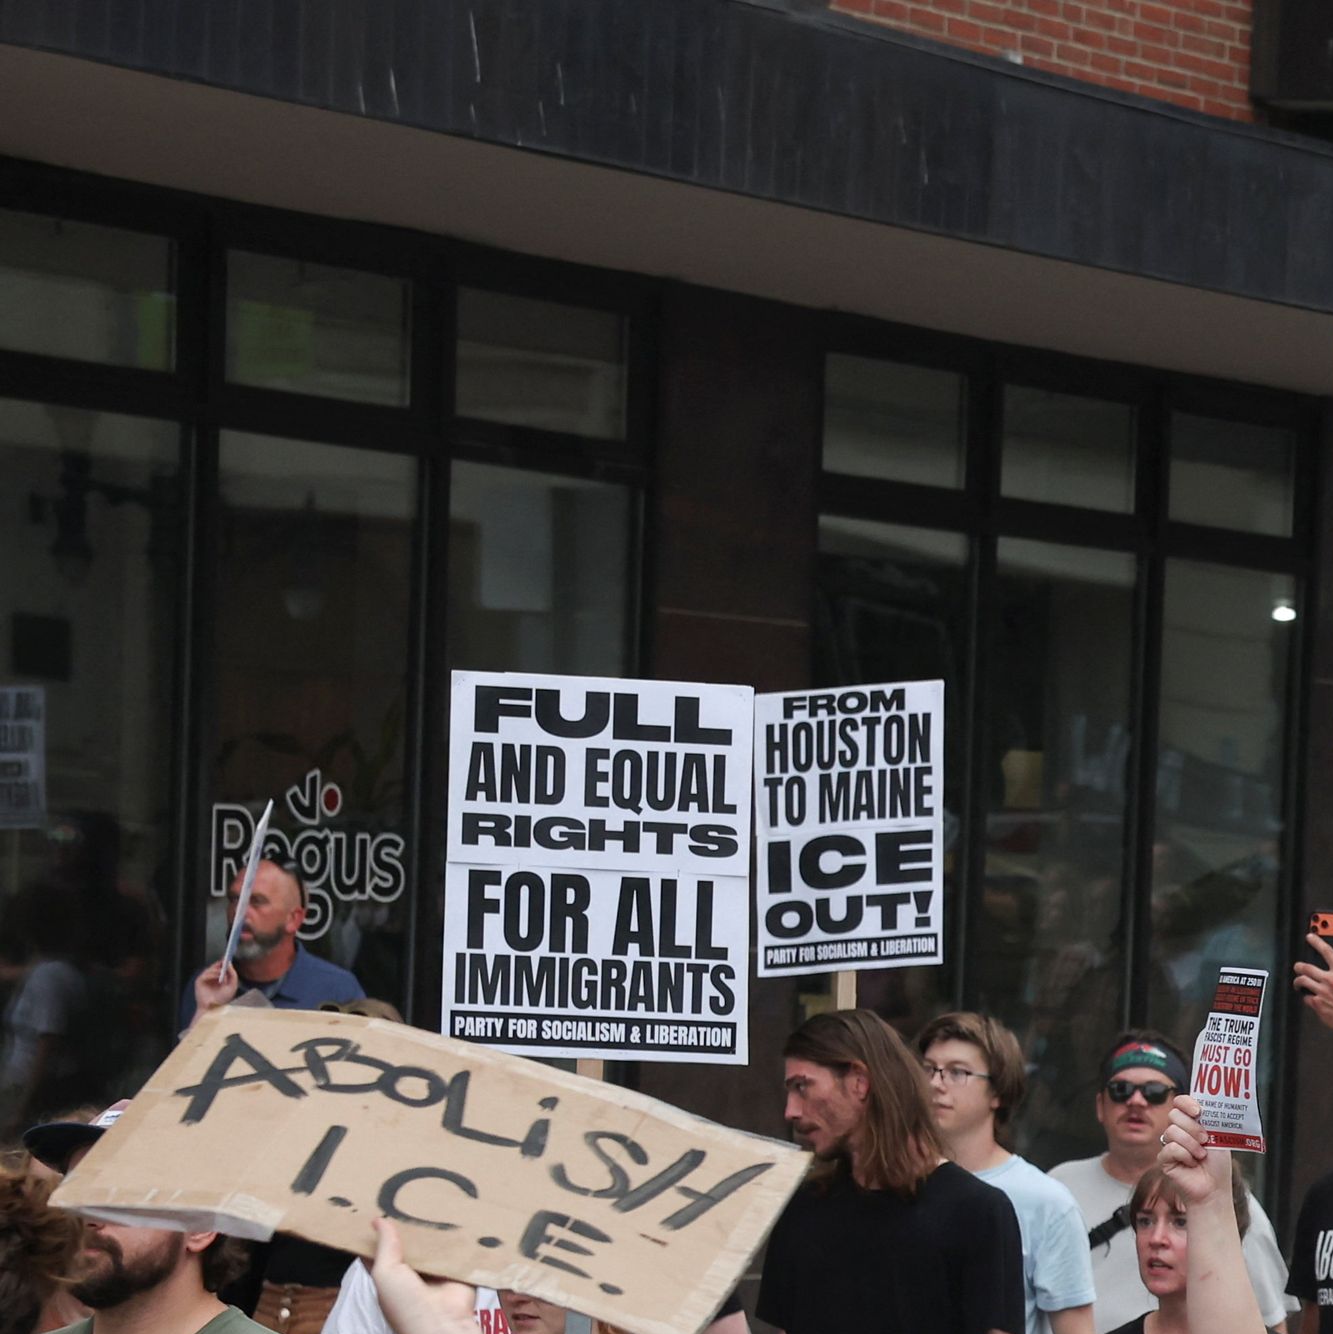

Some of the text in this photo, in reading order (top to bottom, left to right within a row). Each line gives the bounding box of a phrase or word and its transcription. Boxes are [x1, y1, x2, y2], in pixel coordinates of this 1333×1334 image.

[474, 685, 733, 746] FULL
[783, 688, 906, 719] FROM
[765, 712, 931, 775] HOUSTON
[464, 741, 737, 815] AND EQUAL
[764, 766, 934, 828] TO MAINE
[461, 812, 739, 858] RIGHTS
[767, 829, 934, 895] ICE
[466, 869, 729, 961] FOR ALL
[765, 890, 934, 940] OUT!
[766, 936, 935, 965] PARTY FOR SOCIALISM & LIBERATION
[454, 952, 735, 1016] IMMIGRANTS
[454, 1016, 732, 1048] PARTY FOR SOCIALISM & LIBERATION
[1204, 1032, 1253, 1046] FASCIST REGIME
[1207, 1017, 1254, 1035] THE TRUMP
[1200, 1044, 1251, 1067] MUST GO
[1193, 1064, 1251, 1100] NOW!
